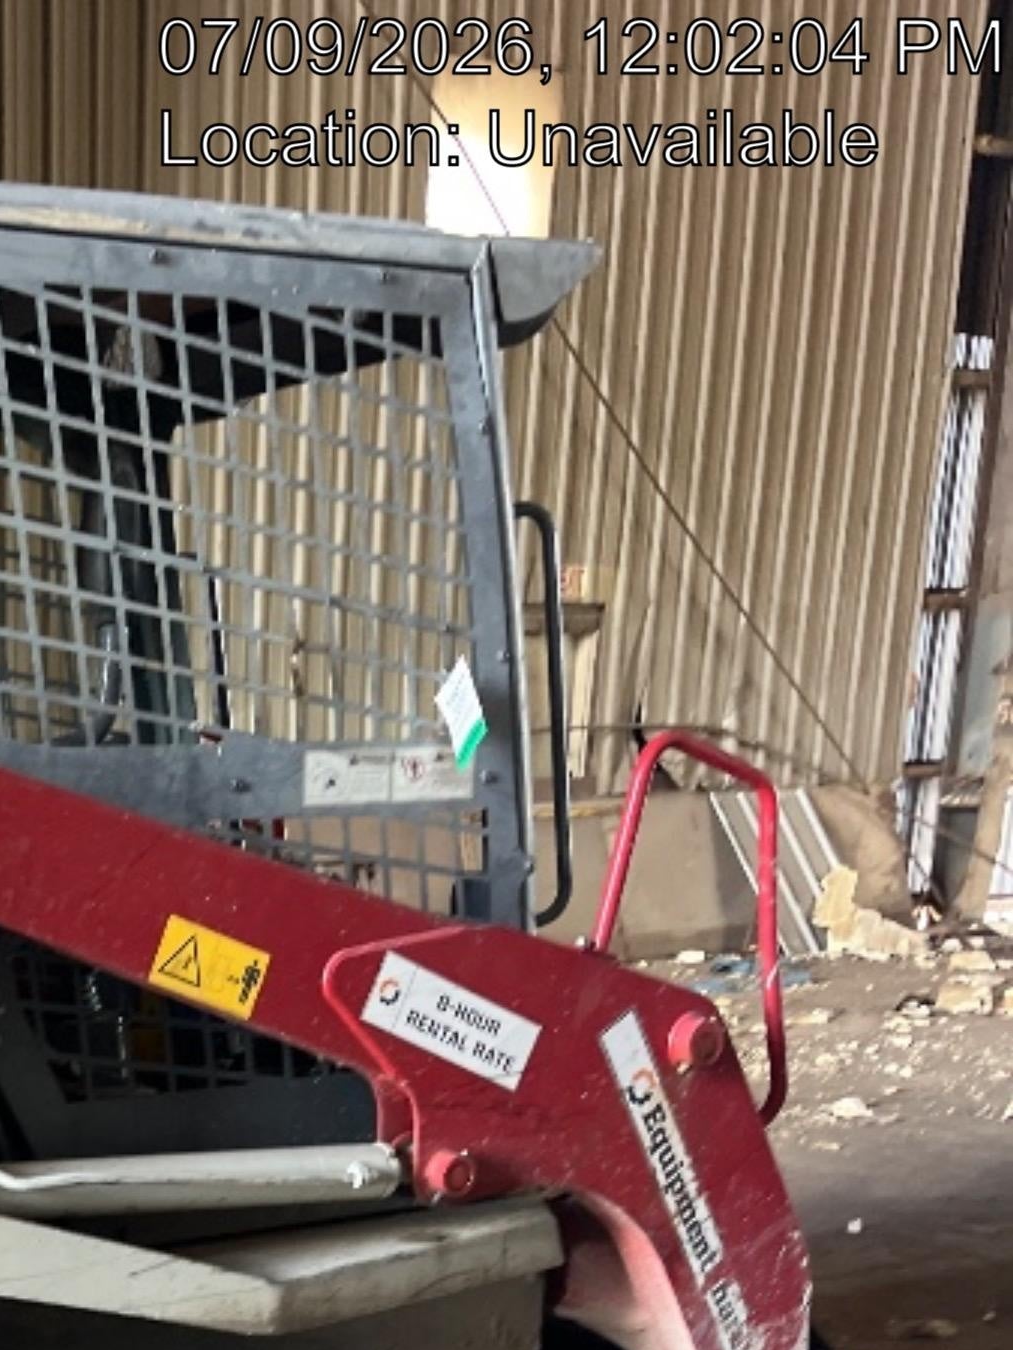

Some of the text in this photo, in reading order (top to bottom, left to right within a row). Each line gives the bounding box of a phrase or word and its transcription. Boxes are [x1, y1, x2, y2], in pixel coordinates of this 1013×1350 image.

[406, 1009, 516, 1073] RENTAL RATE
[435, 993, 502, 1036] 8-HOUR
